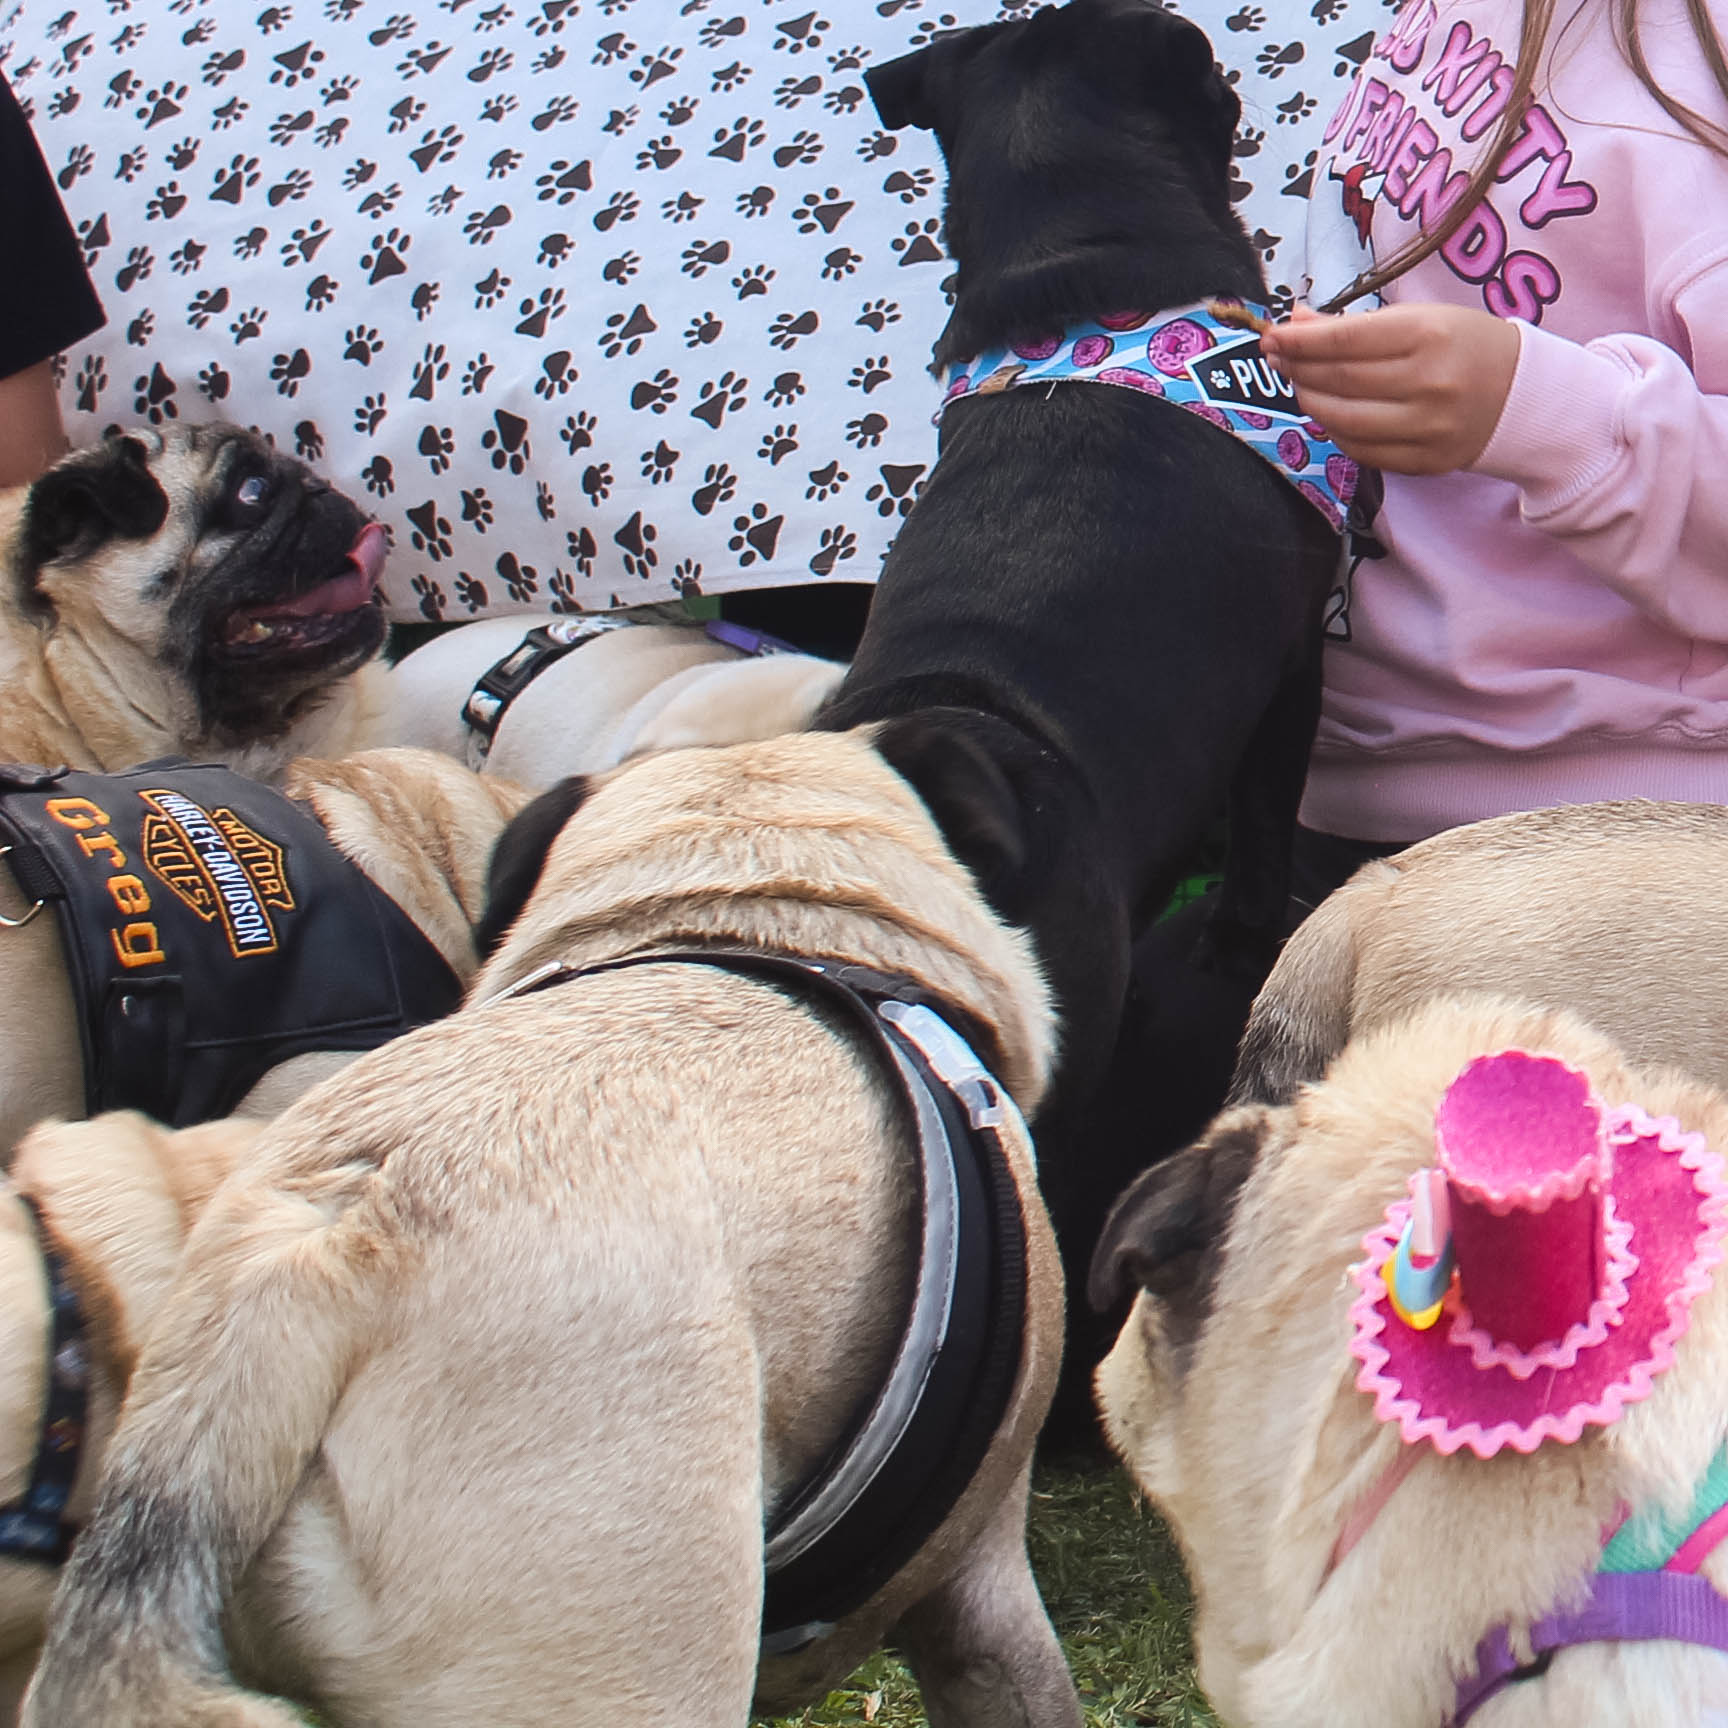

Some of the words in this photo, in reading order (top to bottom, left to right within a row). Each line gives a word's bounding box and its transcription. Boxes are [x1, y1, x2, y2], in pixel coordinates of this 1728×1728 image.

[1343, 76, 1562, 327] FRIENDS
[1421, 20, 1598, 231] KITTY
[44, 796, 166, 969] Greg
[150, 823, 212, 906] CYCLES
[153, 792, 271, 945] HARLEY-DAVIDSON
[217, 818, 281, 896] MOTOR
